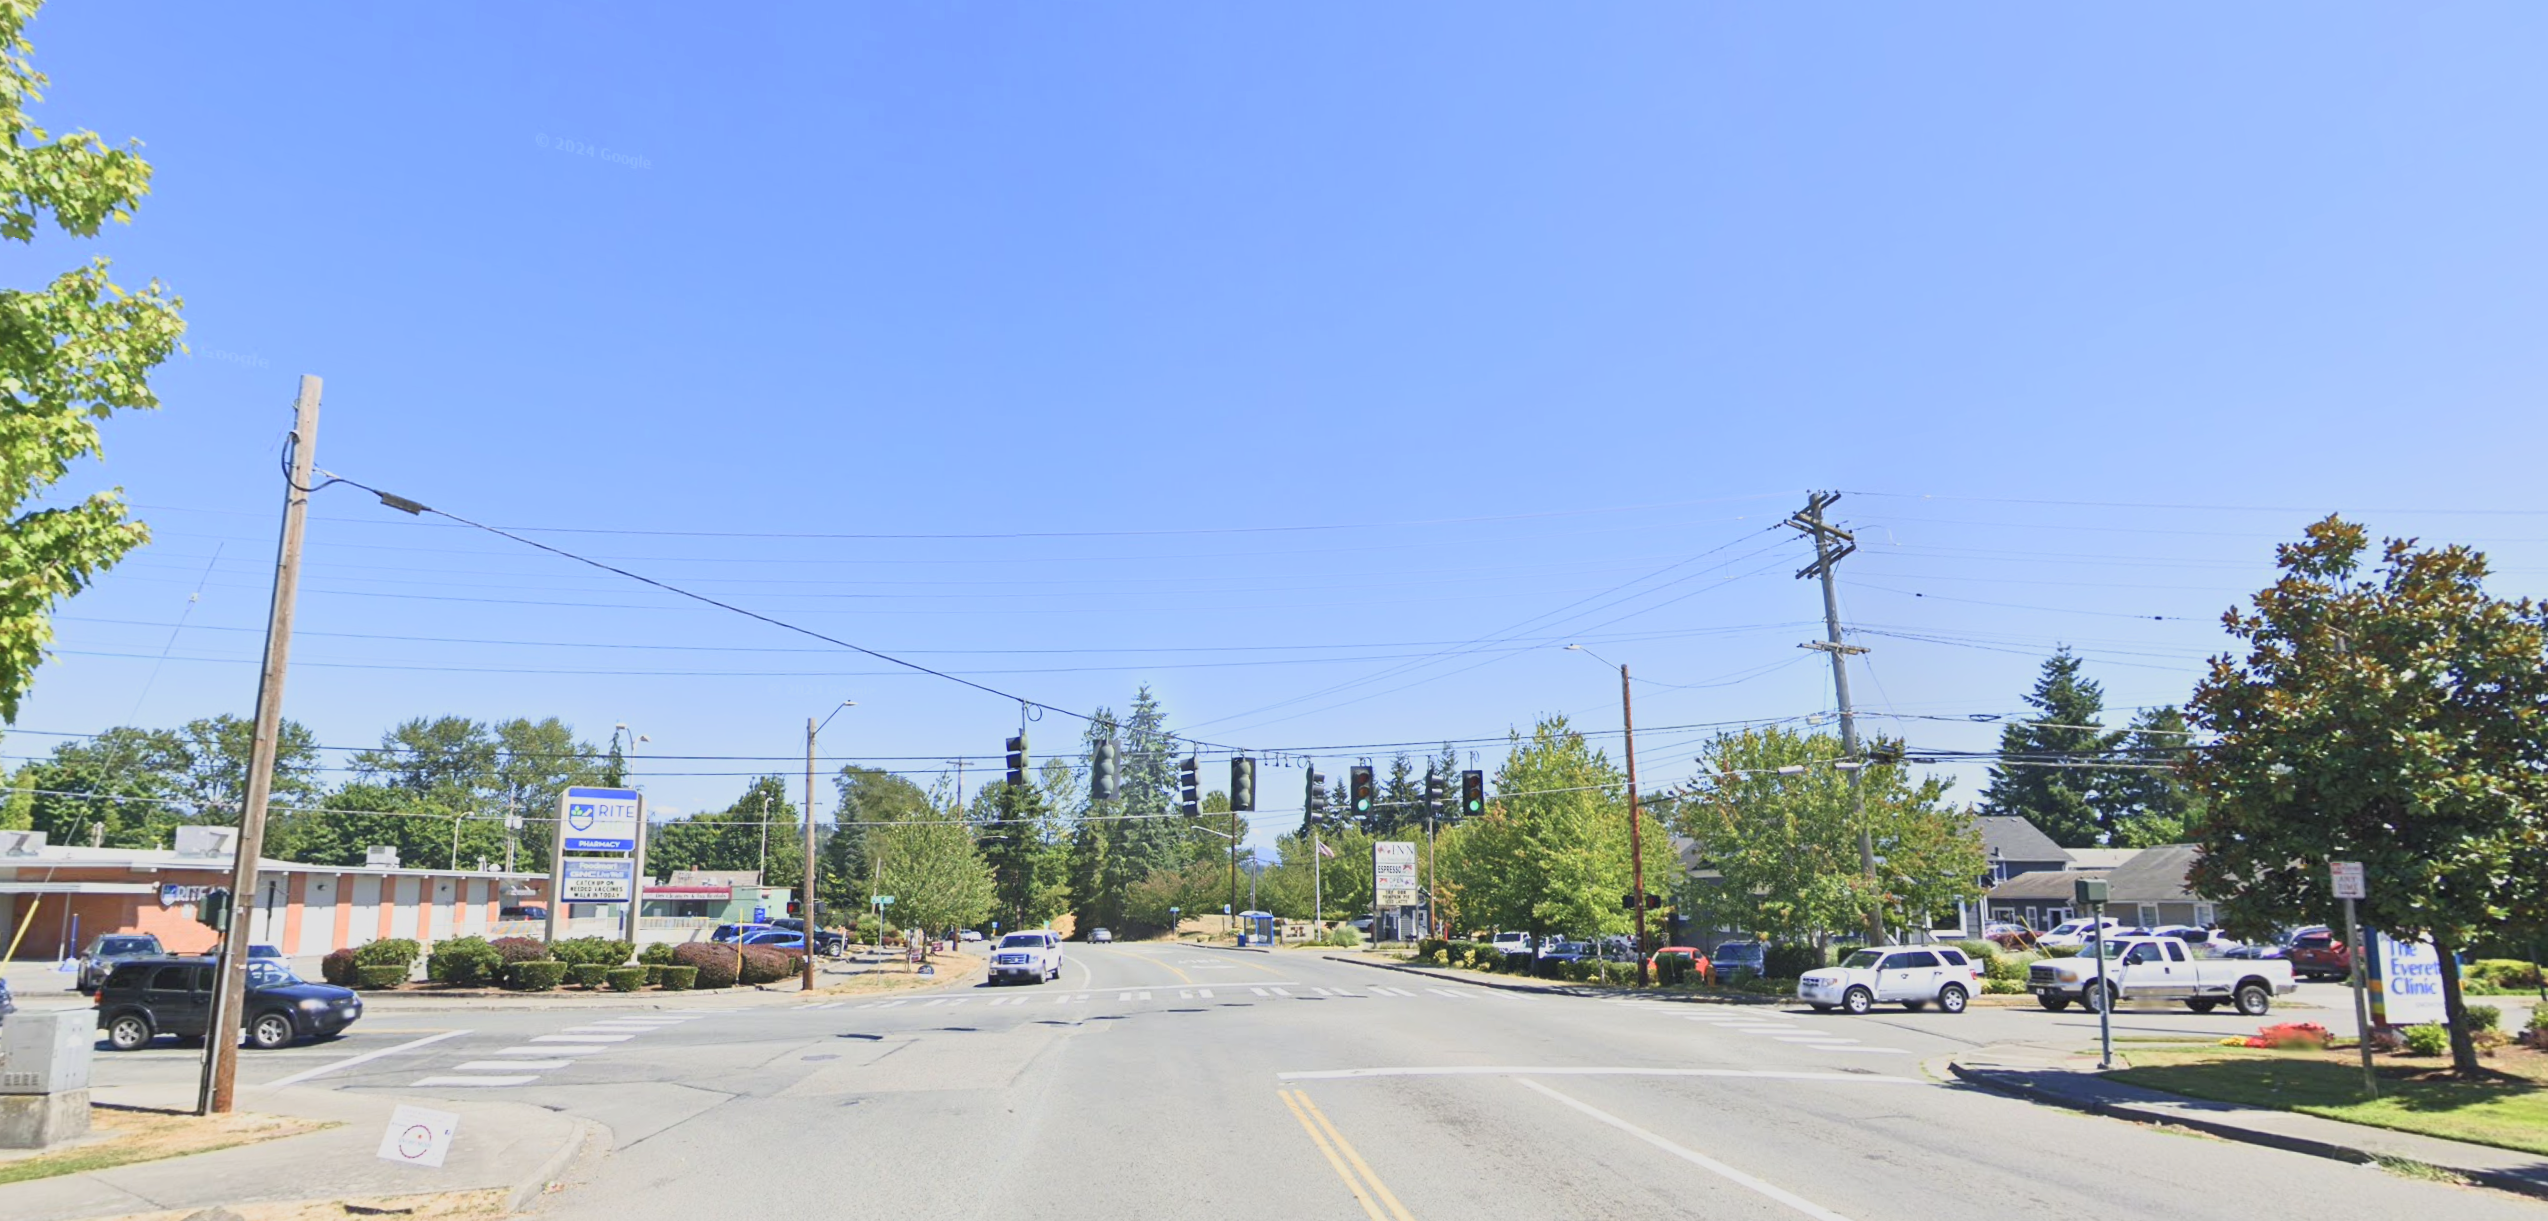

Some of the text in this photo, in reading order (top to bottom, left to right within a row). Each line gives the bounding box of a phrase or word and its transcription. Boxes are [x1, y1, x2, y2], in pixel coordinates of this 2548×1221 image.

[599, 804, 634, 817] RITE
[597, 820, 625, 832] AID
[1392, 845, 1413, 854] INN
[1378, 866, 1401, 874] ESPRESSO
[2391, 977, 2437, 995] Clinic
